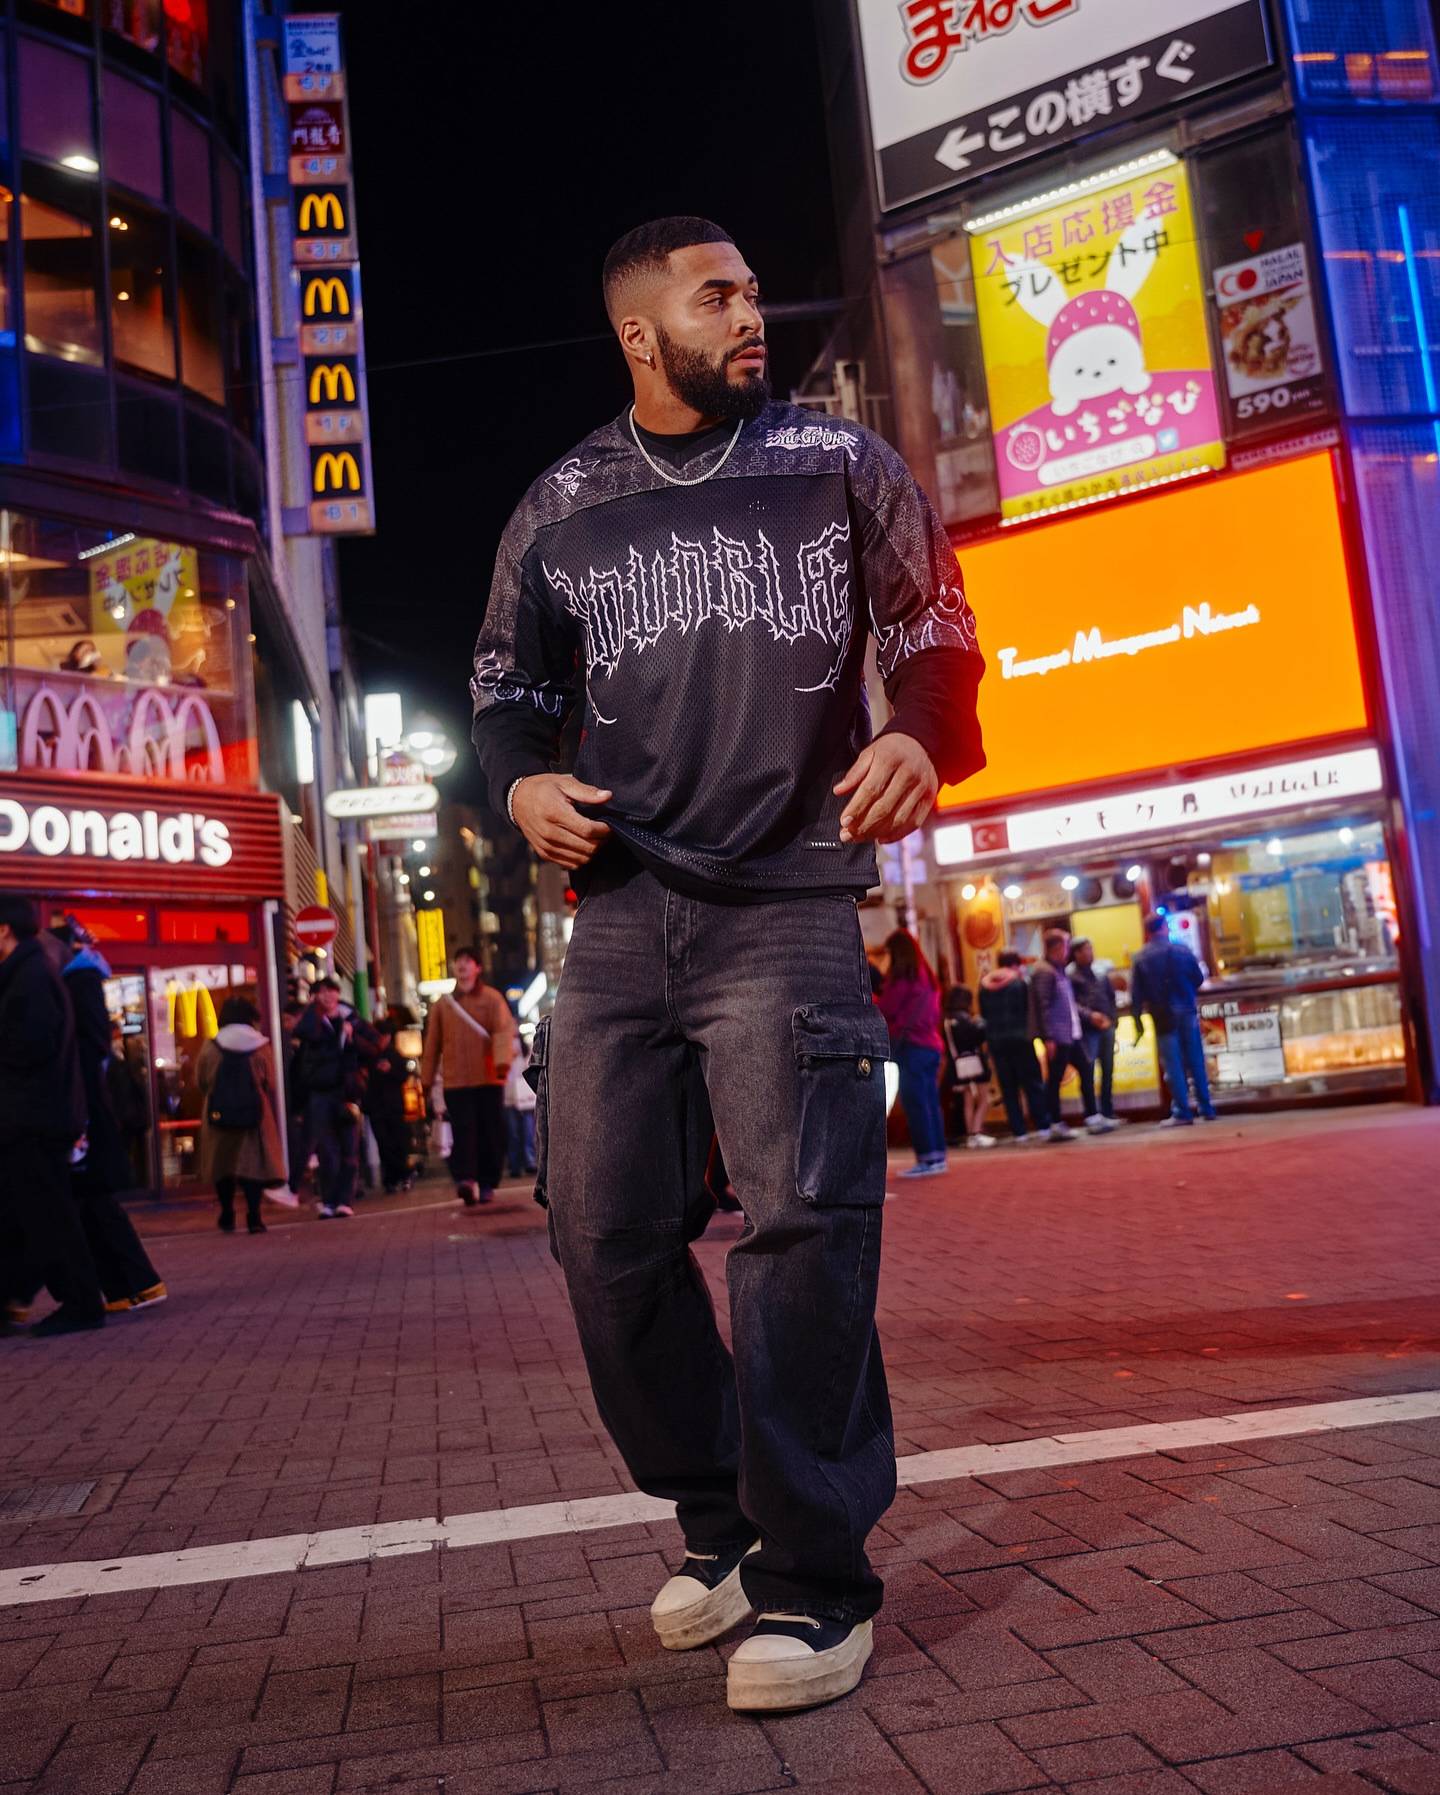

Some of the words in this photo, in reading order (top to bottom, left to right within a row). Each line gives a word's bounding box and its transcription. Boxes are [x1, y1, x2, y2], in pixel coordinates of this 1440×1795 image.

[988, 39, 1196, 152] この横すぐ
[986, 181, 1179, 275] 入店応援金
[1046, 379, 1201, 452] いちごなび
[1236, 387, 1290, 418] 590
